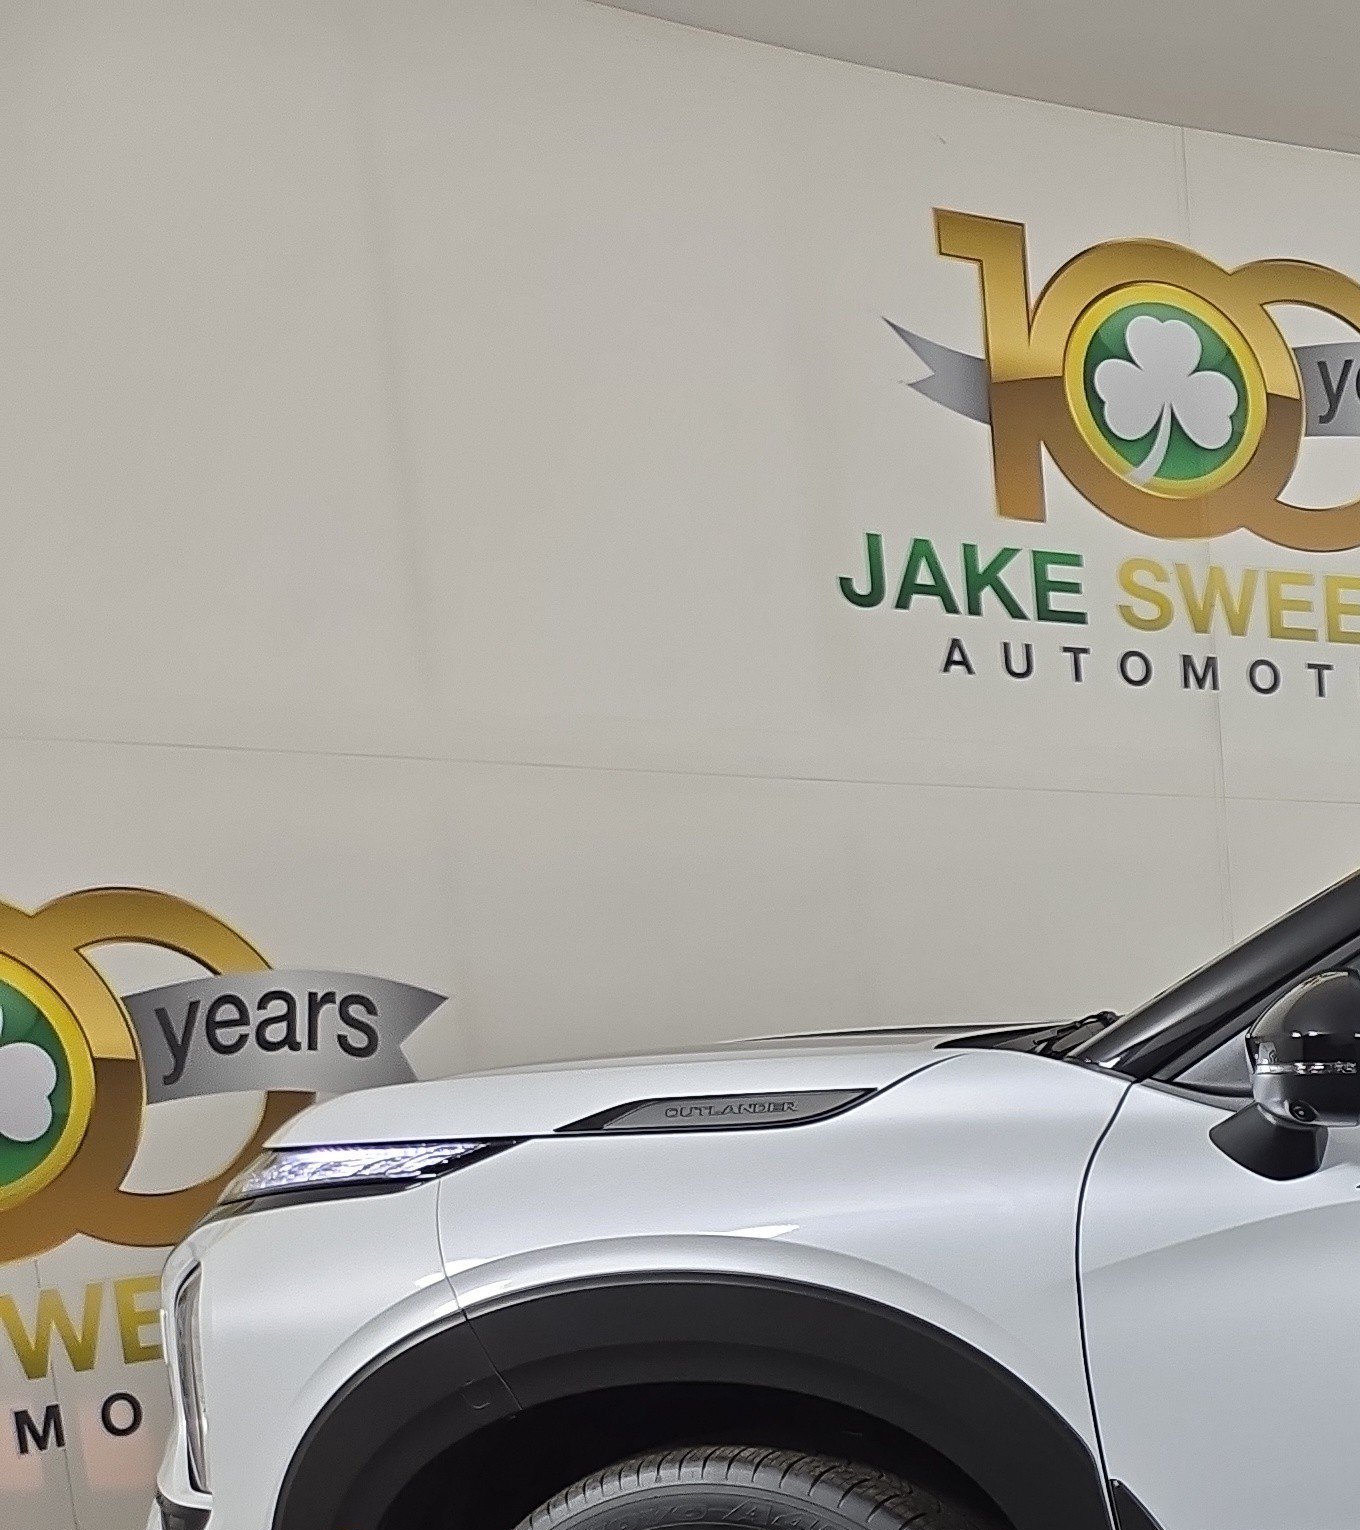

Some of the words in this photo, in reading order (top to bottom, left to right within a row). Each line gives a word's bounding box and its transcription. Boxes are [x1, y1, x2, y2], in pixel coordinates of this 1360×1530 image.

[838, 532, 1090, 626] JAKE
[154, 989, 380, 1086] years
[663, 1100, 799, 1119] OUTLANDER
